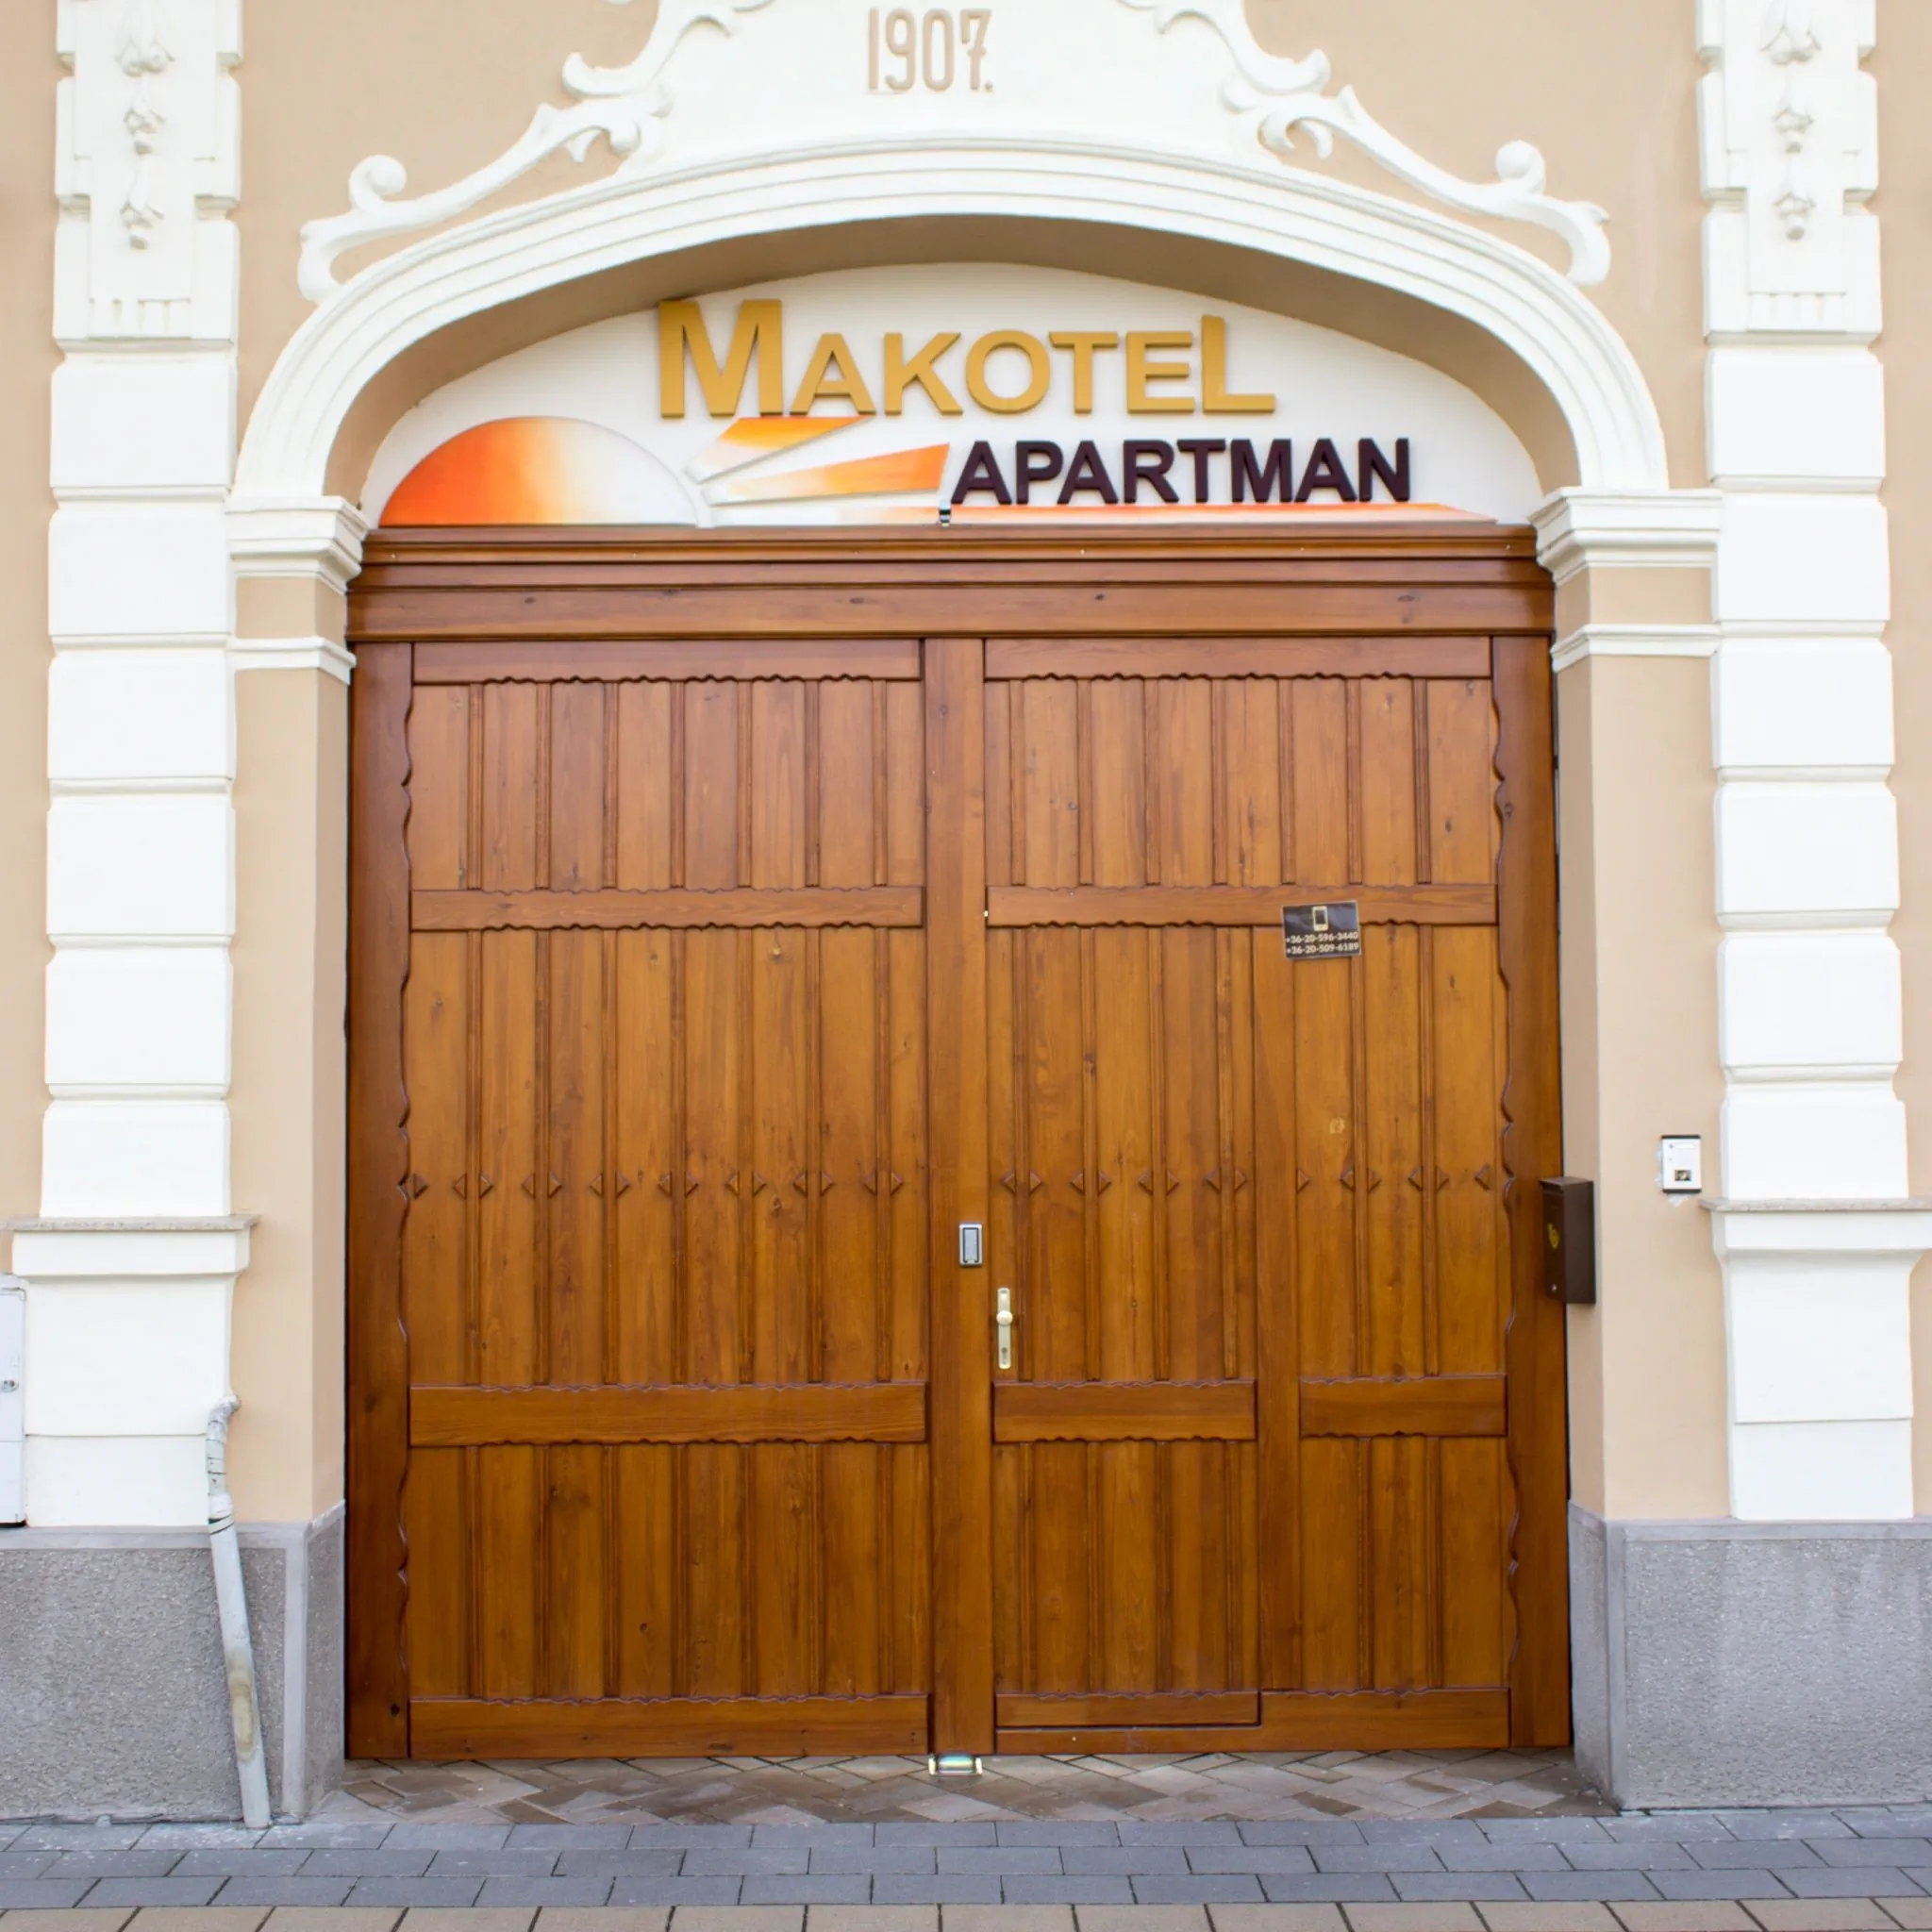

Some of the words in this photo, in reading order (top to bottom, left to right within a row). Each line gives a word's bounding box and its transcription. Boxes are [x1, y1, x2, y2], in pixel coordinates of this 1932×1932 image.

[868, 7, 994, 92] 1907.
[658, 299, 1276, 418] MAKOTEL
[950, 437, 1410, 505] APARTMAN
